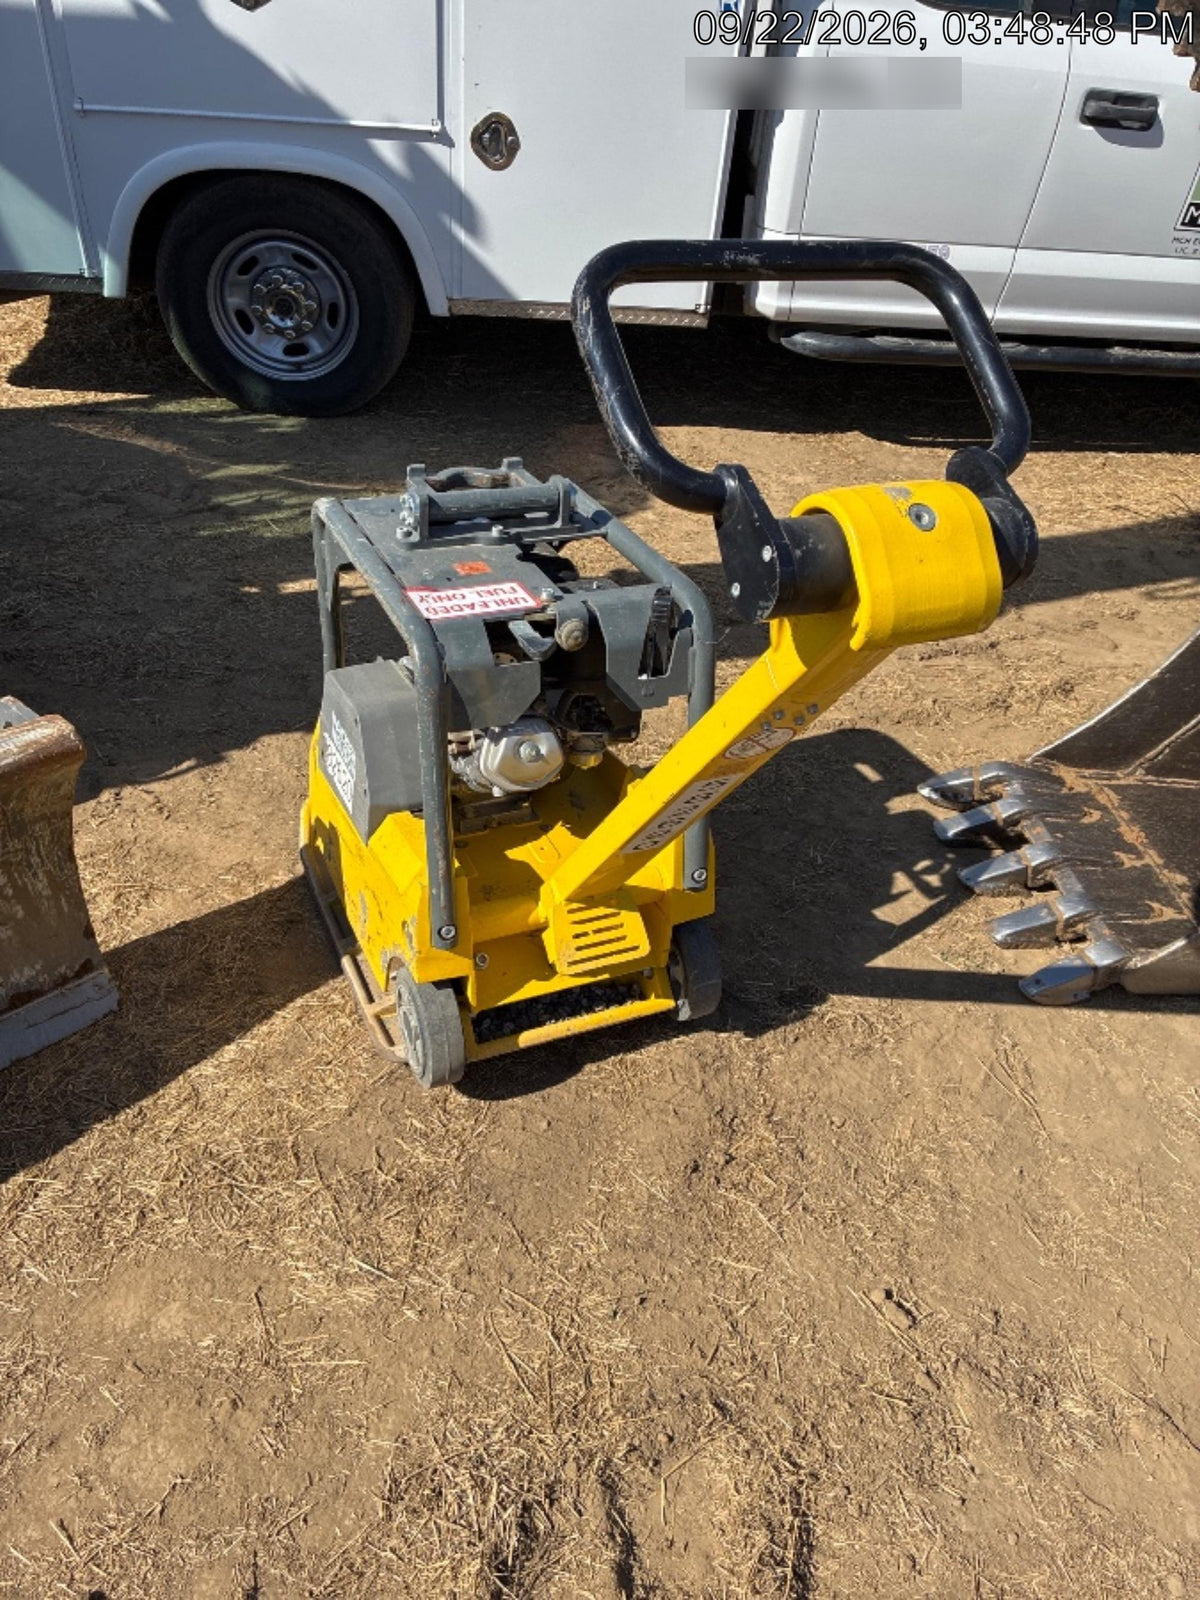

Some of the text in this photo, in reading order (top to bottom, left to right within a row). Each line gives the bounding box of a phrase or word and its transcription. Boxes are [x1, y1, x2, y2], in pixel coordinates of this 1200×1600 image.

[418, 586, 518, 605] FUEL ONLY
[424, 596, 529, 616] UNLEADED
